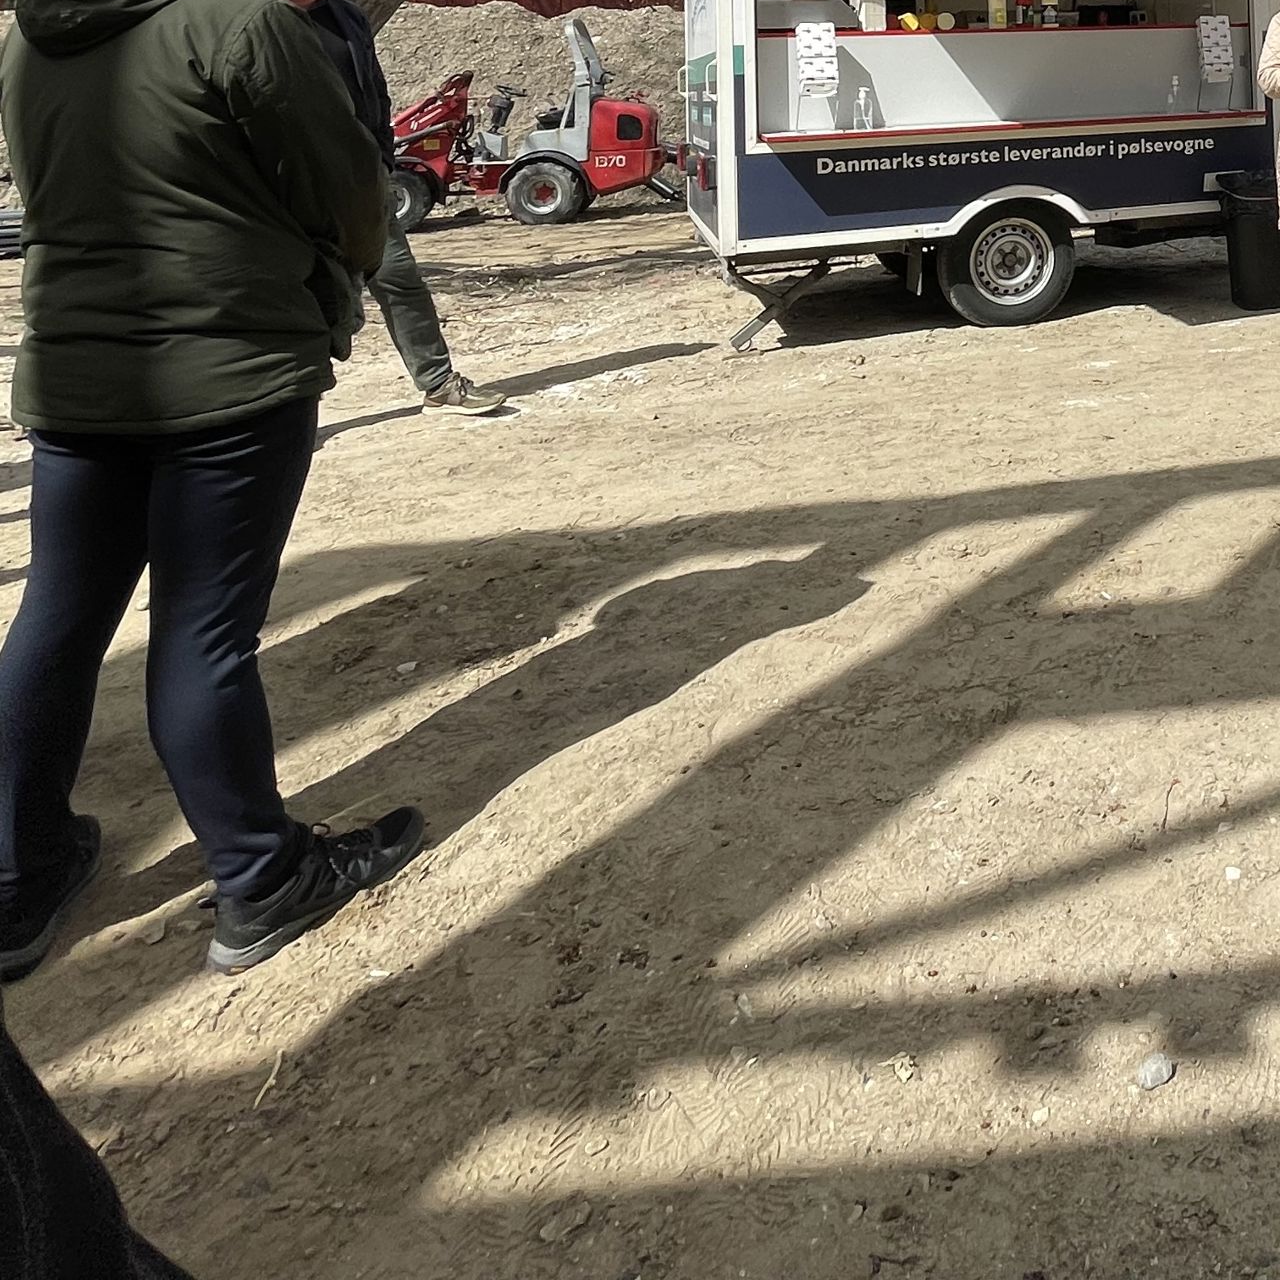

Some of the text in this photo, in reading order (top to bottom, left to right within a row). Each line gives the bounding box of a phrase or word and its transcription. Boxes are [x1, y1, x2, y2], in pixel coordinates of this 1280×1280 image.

[816, 138, 1215, 175] Danmarks største leverandør i pølsevogne
